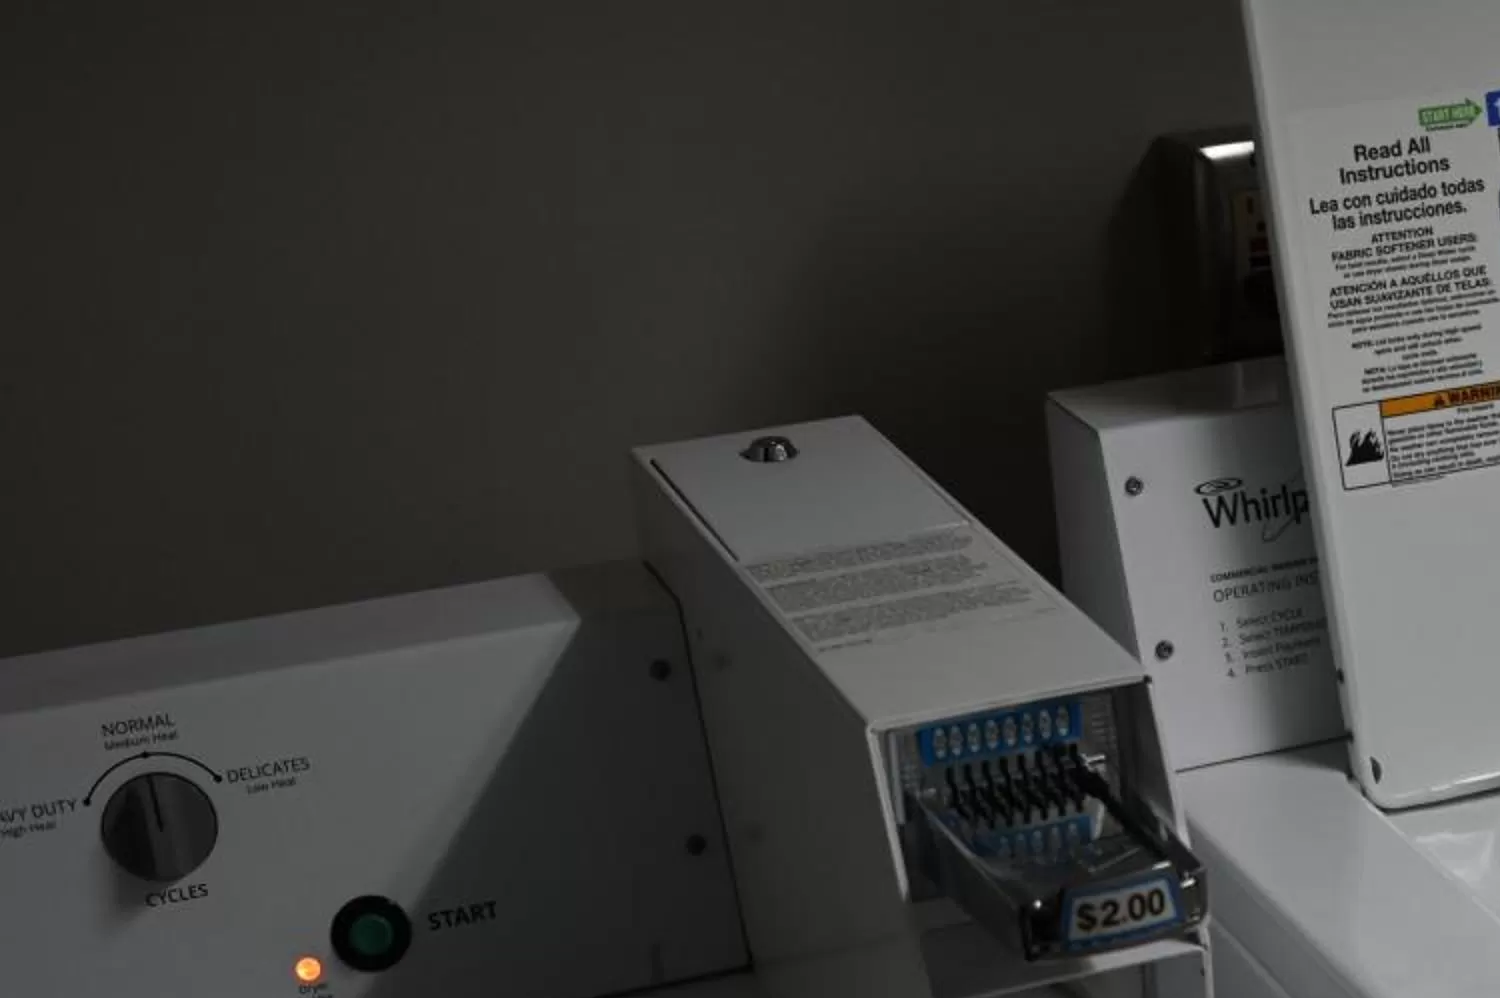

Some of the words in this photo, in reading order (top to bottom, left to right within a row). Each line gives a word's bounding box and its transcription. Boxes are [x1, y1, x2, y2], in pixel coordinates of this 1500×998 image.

[1353, 138, 1403, 162] Read
[1407, 135, 1432, 154] All
[1339, 157, 1451, 185] Instructions
[1309, 197, 1339, 215] Lea
[1343, 194, 1373, 211] con
[1375, 182, 1437, 206] cuidado
[1442, 177, 1486, 198] todas
[1331, 214, 1356, 231] las
[1359, 201, 1468, 227] instrucciones.
[1371, 226, 1434, 245] ATTENTION
[1331, 247, 1373, 262] FABRIC
[1375, 239, 1436, 256] SOFTENER
[1389, 278, 1398, 288] A
[1463, 264, 1488, 278] QUE
[1330, 296, 1363, 311] USAN
[1436, 283, 1451, 295] DE
[1202, 483, 1309, 528] Whirlp
[1213, 578, 1293, 603] OPERATING
[1295, 569, 1319, 587] INS
[101, 713, 176, 737] NORMAL
[227, 757, 311, 784] DELICATES
[31, 799, 78, 819] DUTY
[144, 883, 209, 908] CYCLES
[427, 900, 498, 931] START
[1075, 888, 1165, 932] $2.00
